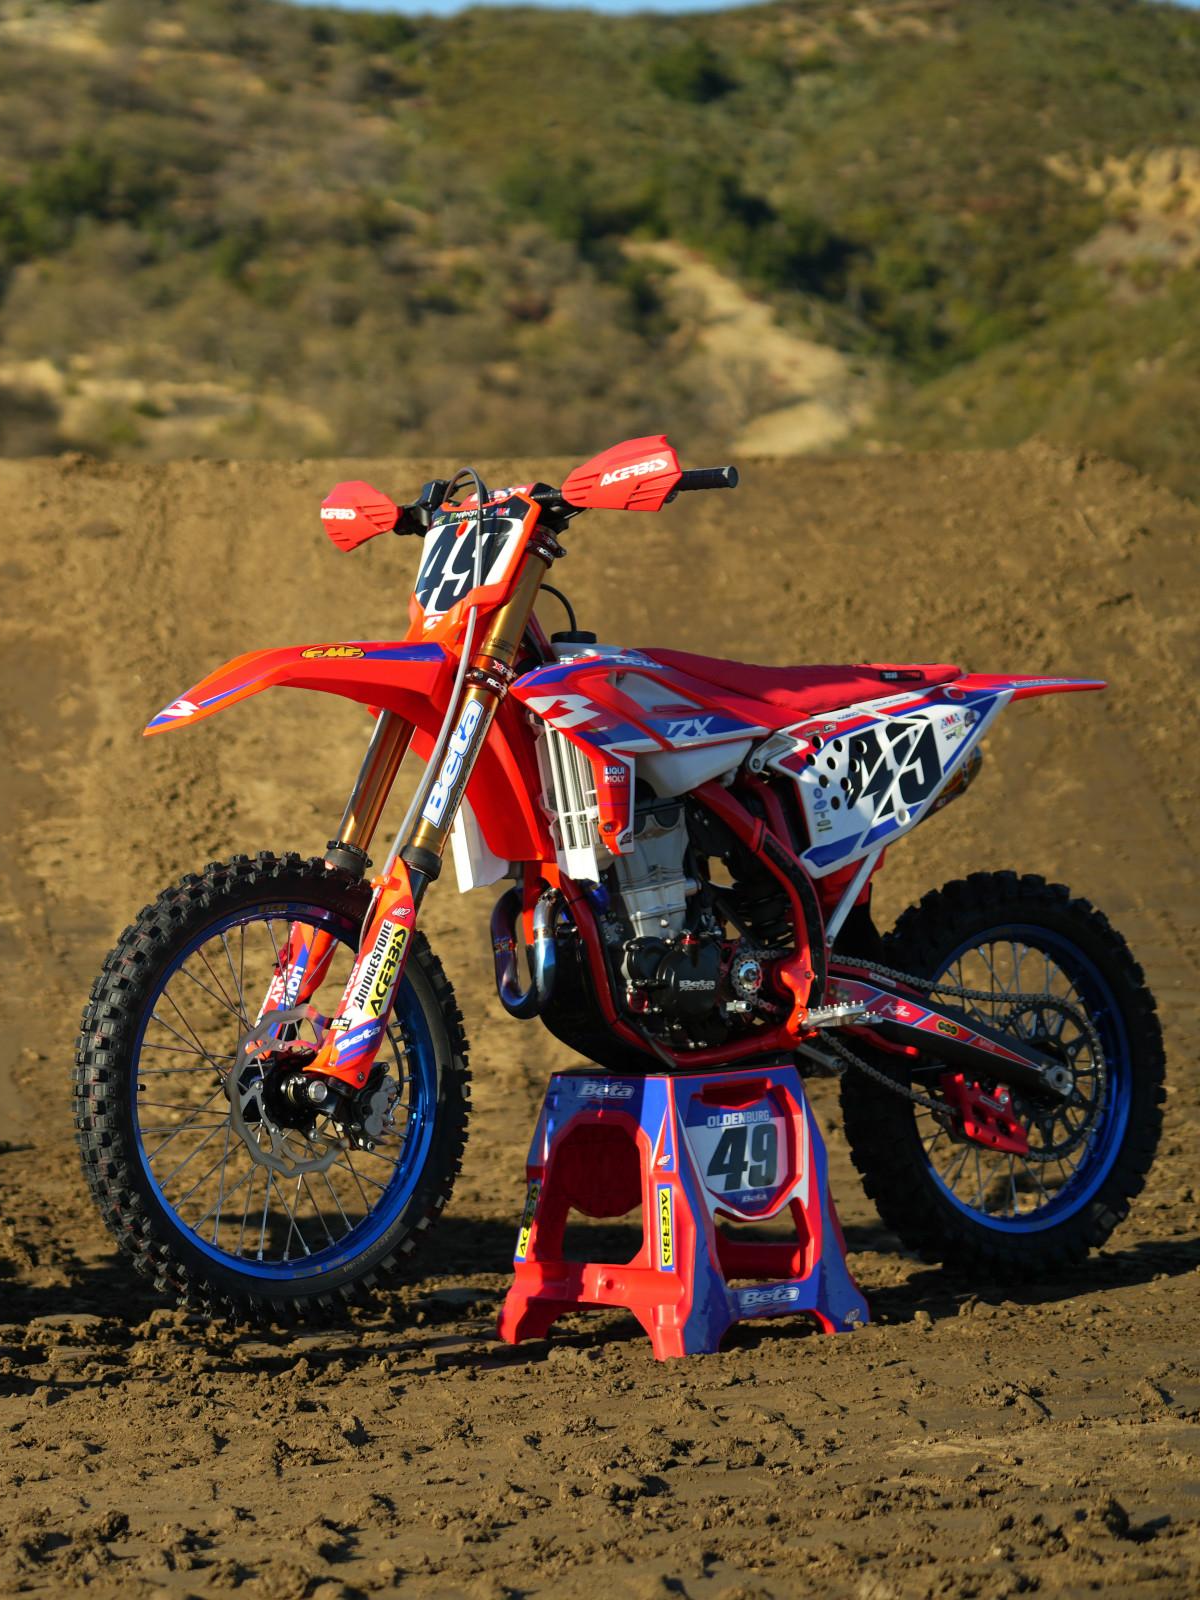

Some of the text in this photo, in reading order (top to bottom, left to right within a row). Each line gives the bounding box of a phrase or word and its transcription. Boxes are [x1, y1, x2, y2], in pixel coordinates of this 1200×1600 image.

[600, 458, 668, 487] ACERBIS
[320, 508, 356, 520] ACERBIS
[455, 508, 487, 519] MONSTR
[414, 518, 514, 612] 49
[300, 644, 365, 660] FMF
[422, 699, 484, 828] Beta
[604, 766, 626, 775] LIQUI
[604, 774, 626, 784] MOLY
[355, 920, 393, 1011] BRIDGESTONE
[366, 928, 407, 1017] ACERBIS
[336, 1024, 382, 1051] Beta
[577, 1081, 635, 1100] Beta
[706, 1109, 771, 1129] OLDENBURG
[706, 1122, 778, 1192] 49
[661, 1192, 671, 1264] ACERBIS
[740, 1284, 800, 1308] Beta
